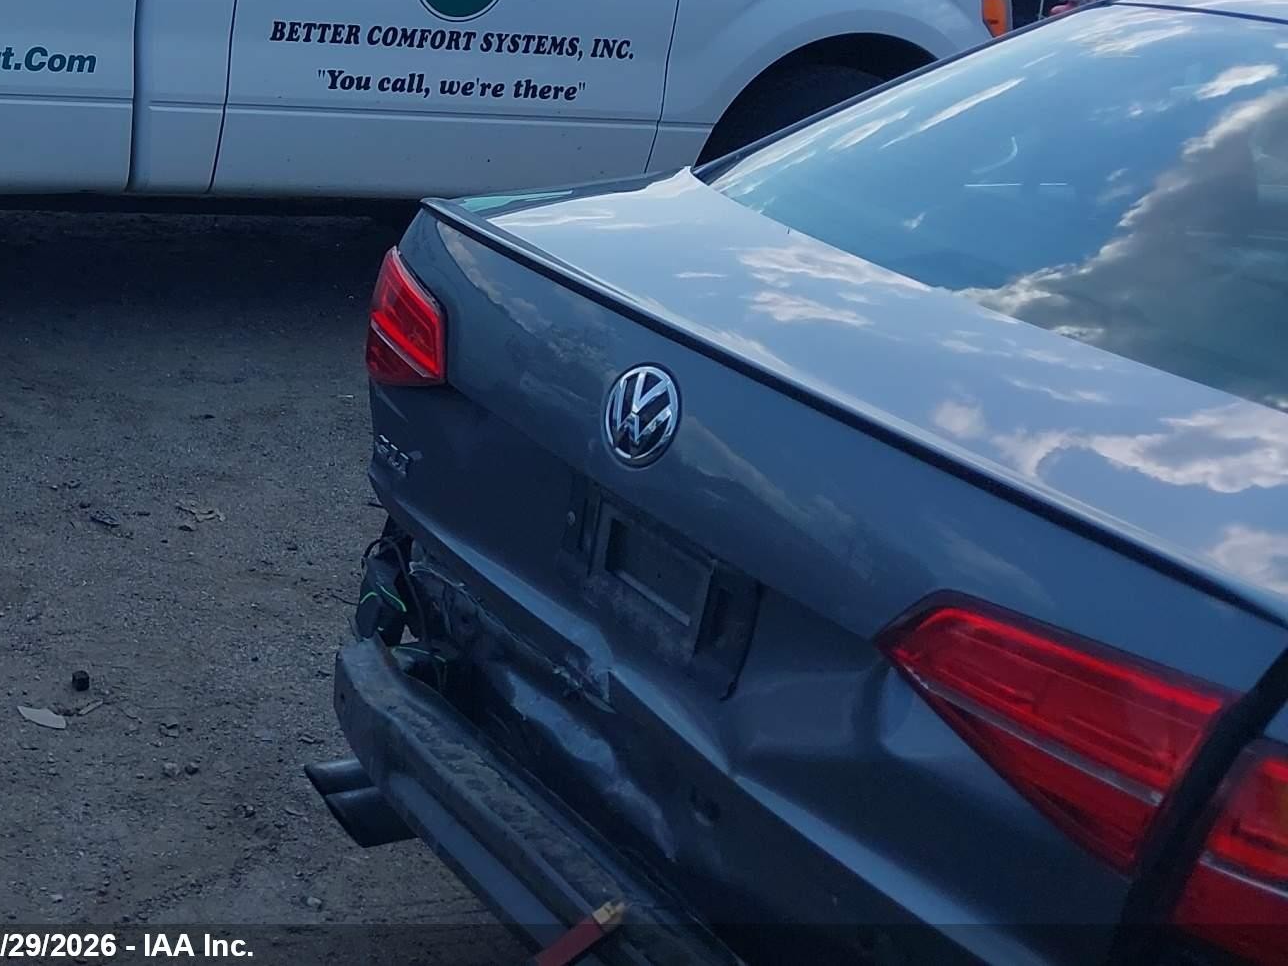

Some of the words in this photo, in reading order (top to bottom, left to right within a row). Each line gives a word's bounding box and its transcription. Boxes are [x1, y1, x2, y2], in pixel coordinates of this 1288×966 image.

[269, 20, 361, 45] BETTER
[366, 26, 476, 52] COMFORT
[479, 32, 584, 61] SYSTEMS,
[590, 38, 635, 60] INC.
[317, 68, 371, 91] "You
[377, 72, 431, 98] call,
[439, 76, 504, 98] we're
[512, 79, 587, 101] there"
